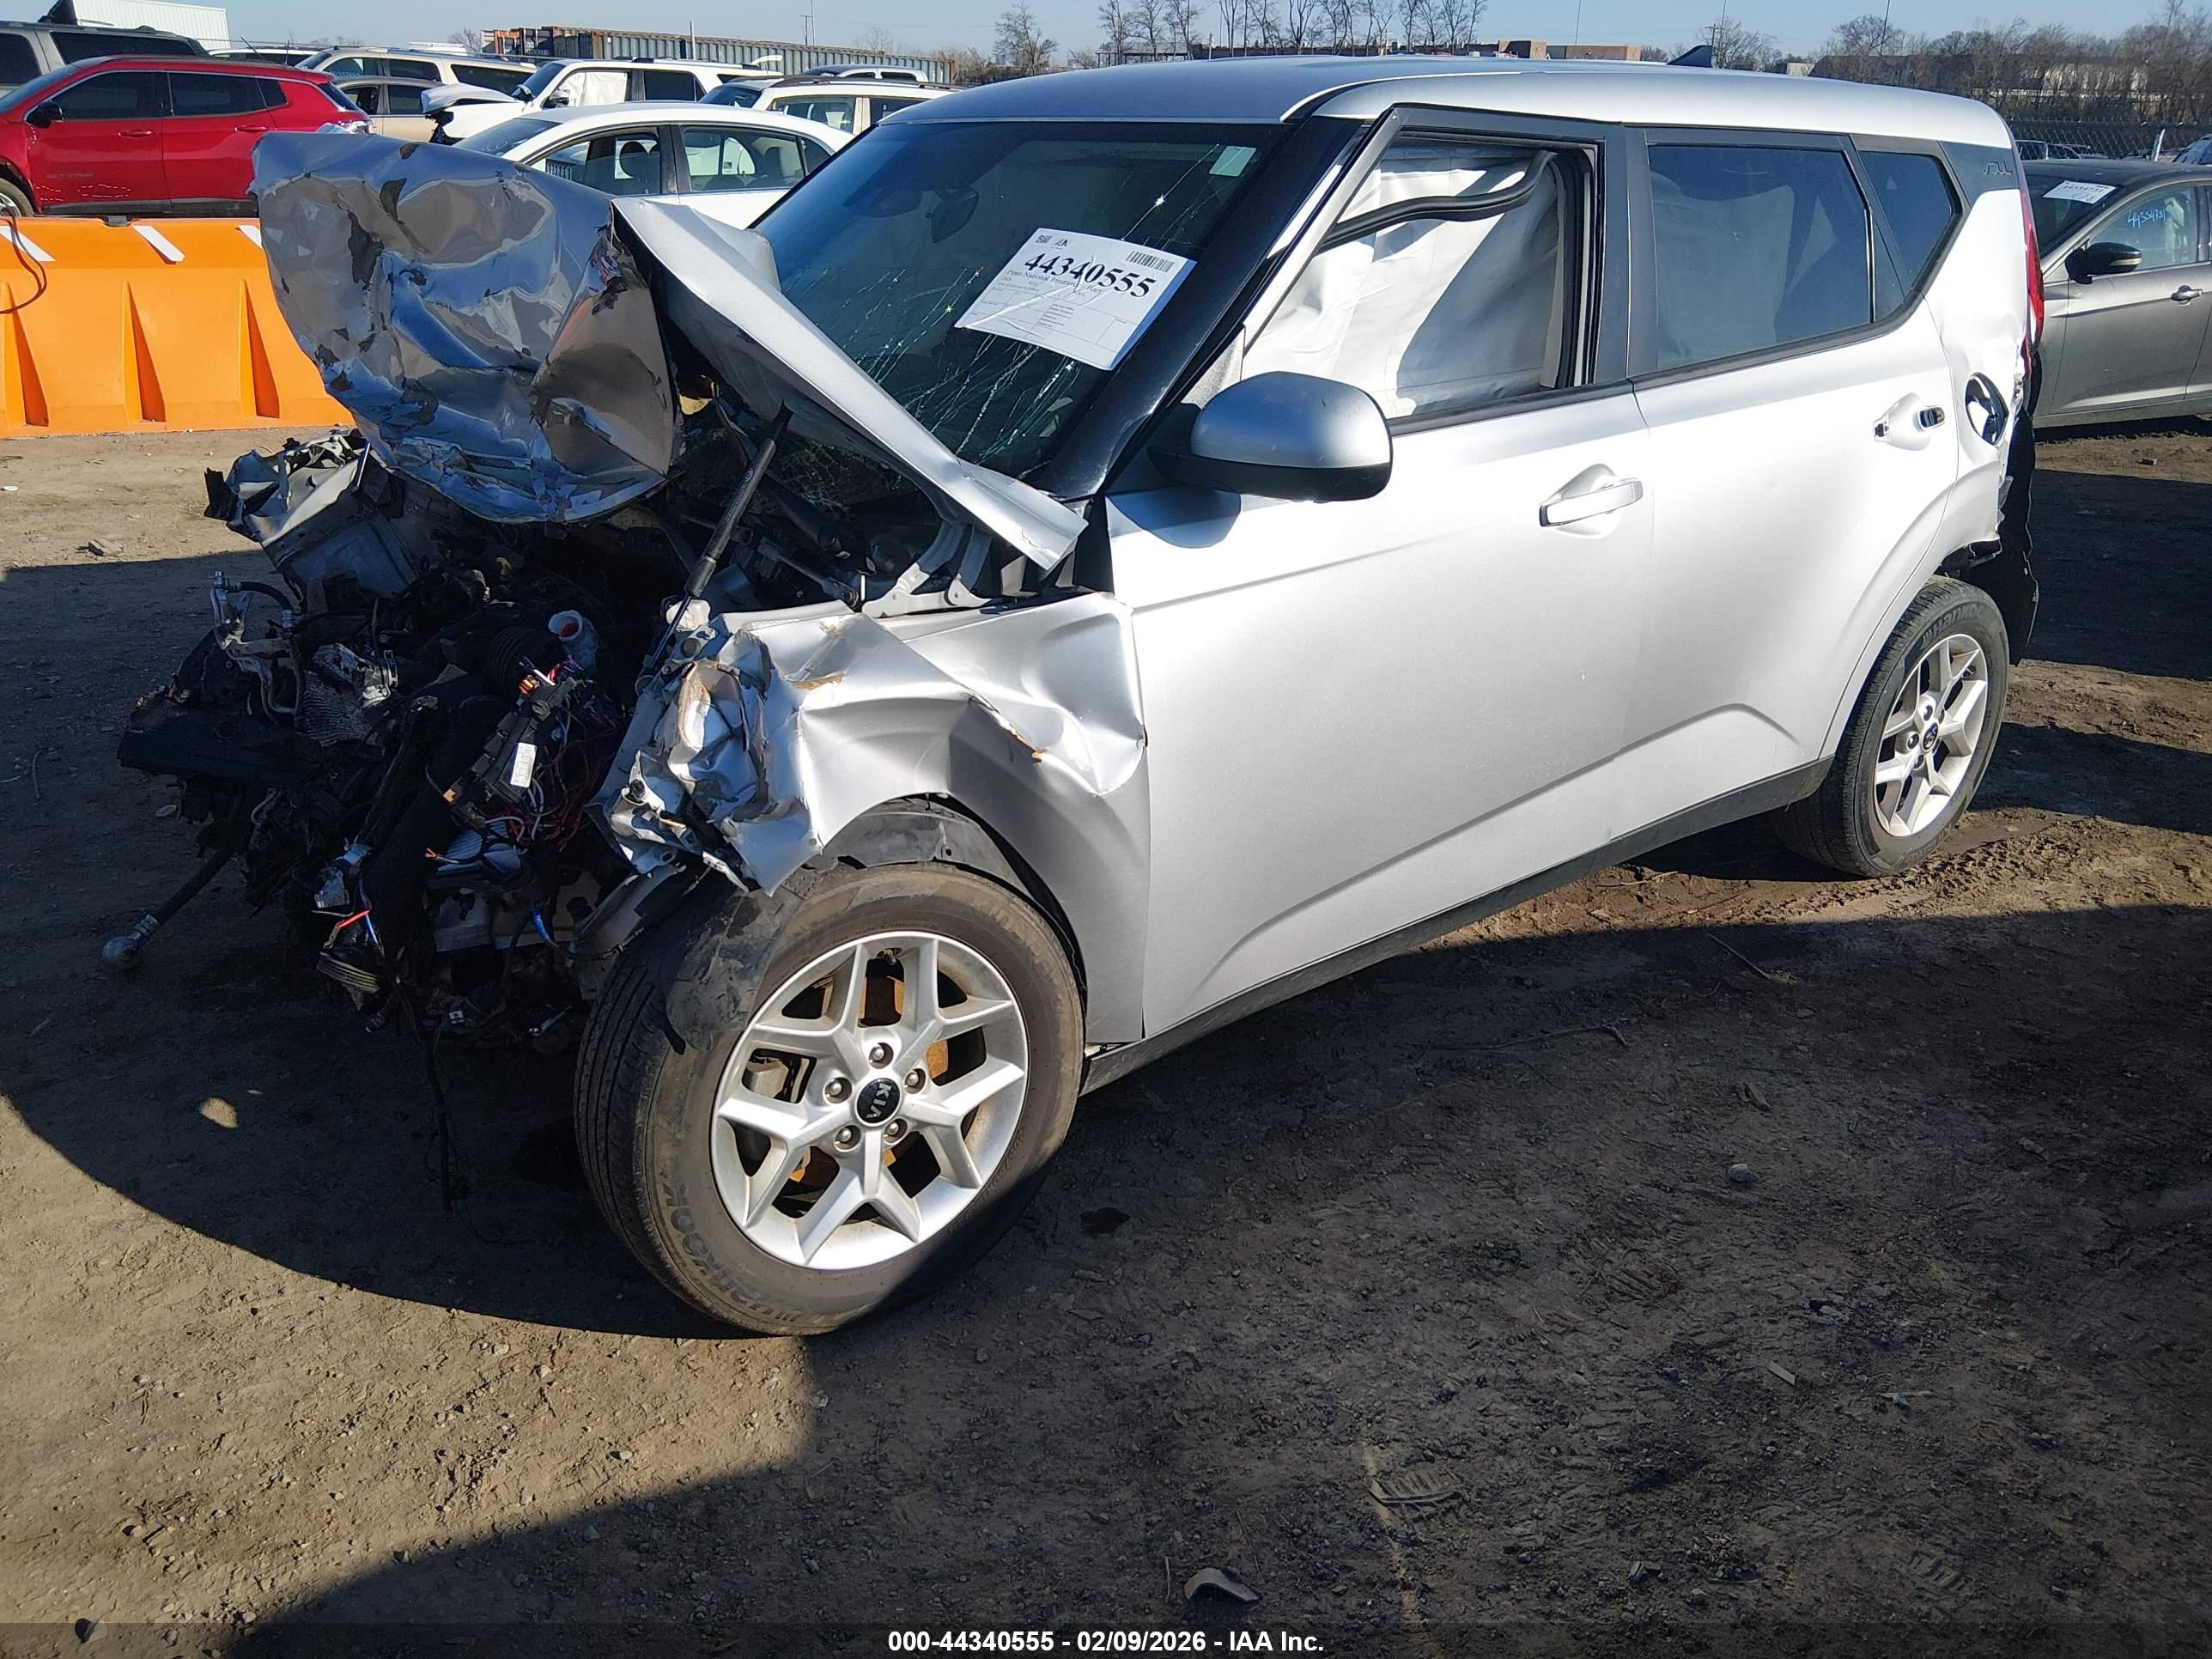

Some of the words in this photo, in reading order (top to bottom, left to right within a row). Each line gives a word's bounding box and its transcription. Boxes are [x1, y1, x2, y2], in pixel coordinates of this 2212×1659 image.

[1024, 252, 1157, 298] 44340555
[1024, 271, 1049, 282] National
[866, 1083, 892, 1119] KIA
